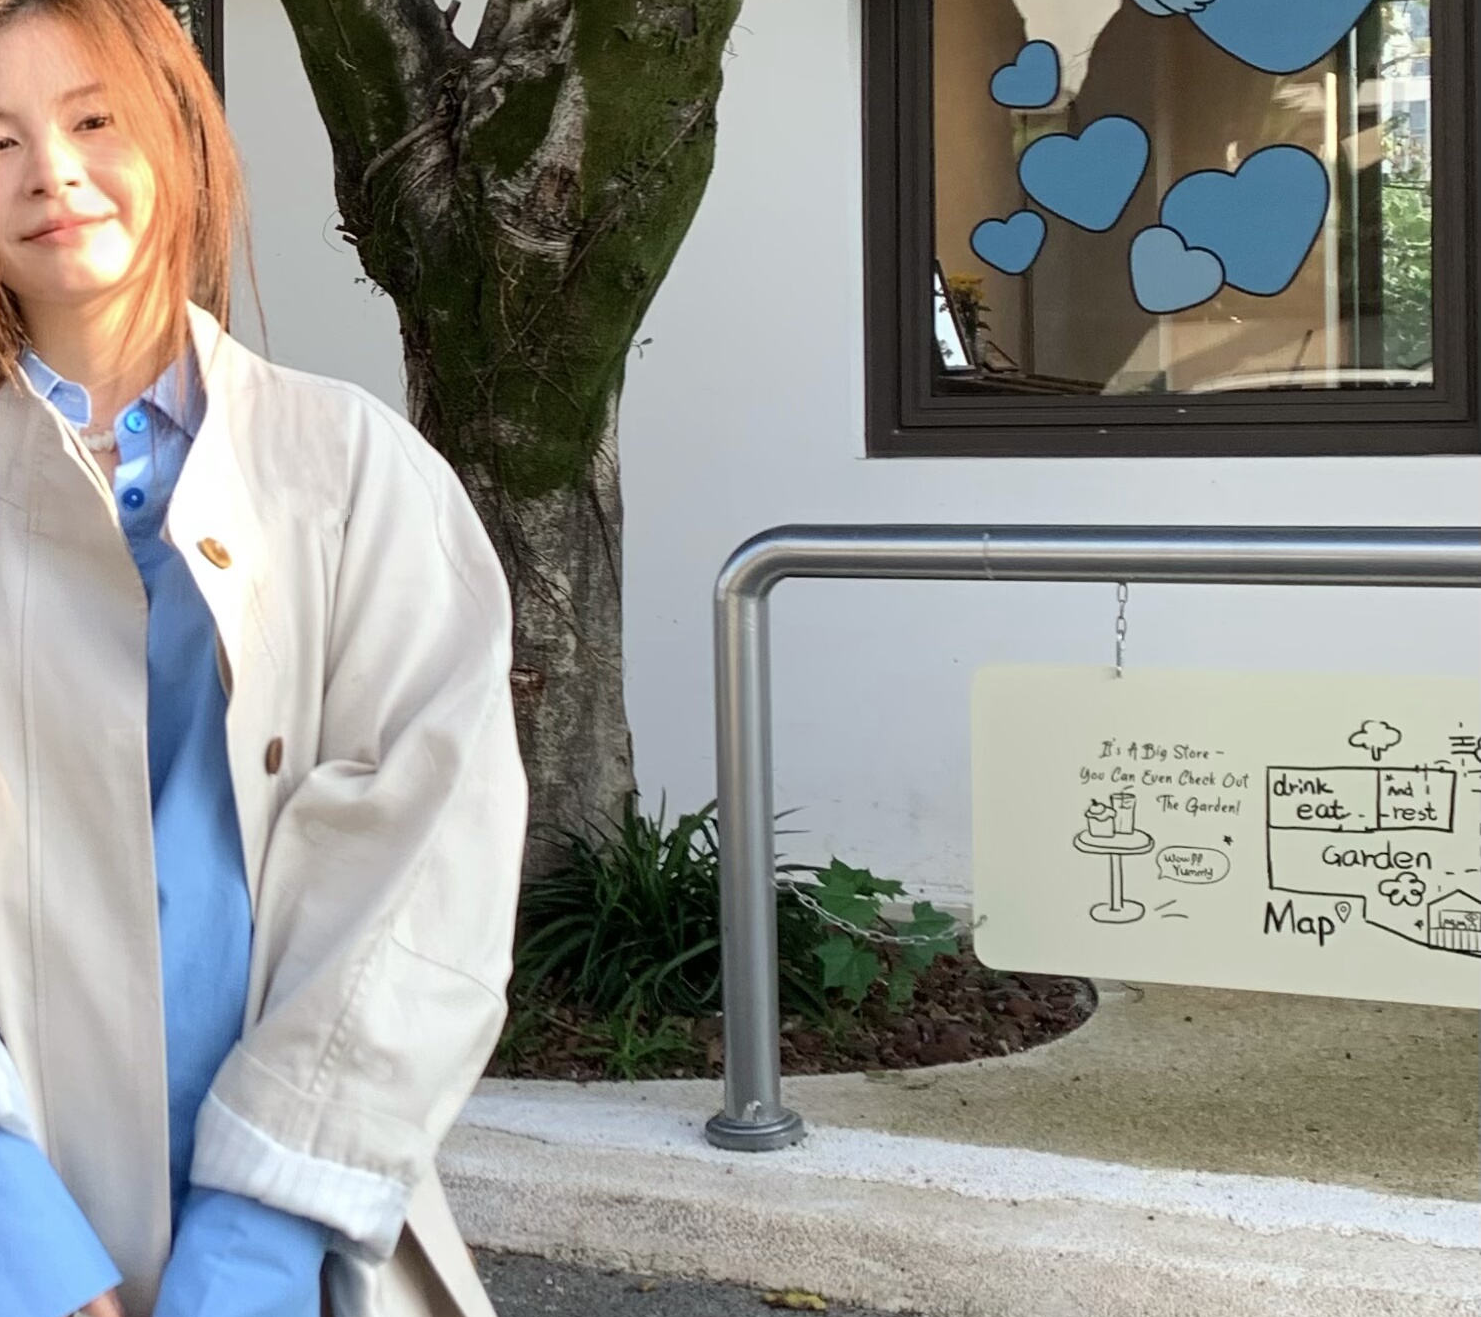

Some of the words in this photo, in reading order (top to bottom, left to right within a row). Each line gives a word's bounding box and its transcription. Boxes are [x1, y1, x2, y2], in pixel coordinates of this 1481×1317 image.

[1127, 741, 1138, 761] A
[1141, 742, 1168, 763] Big
[1173, 744, 1210, 760] Store
[1110, 766, 1136, 783] Can
[1141, 769, 1173, 786] Even
[1178, 769, 1216, 787] Check
[1222, 772, 1251, 789] Out
[1273, 773, 1334, 797] drink
[1155, 794, 1179, 813] The
[1185, 796, 1241, 817] Garden!
[1296, 799, 1347, 821] eat
[1393, 801, 1438, 822] rest
[1322, 840, 1433, 871] Garden
[1263, 899, 1336, 948] Map
